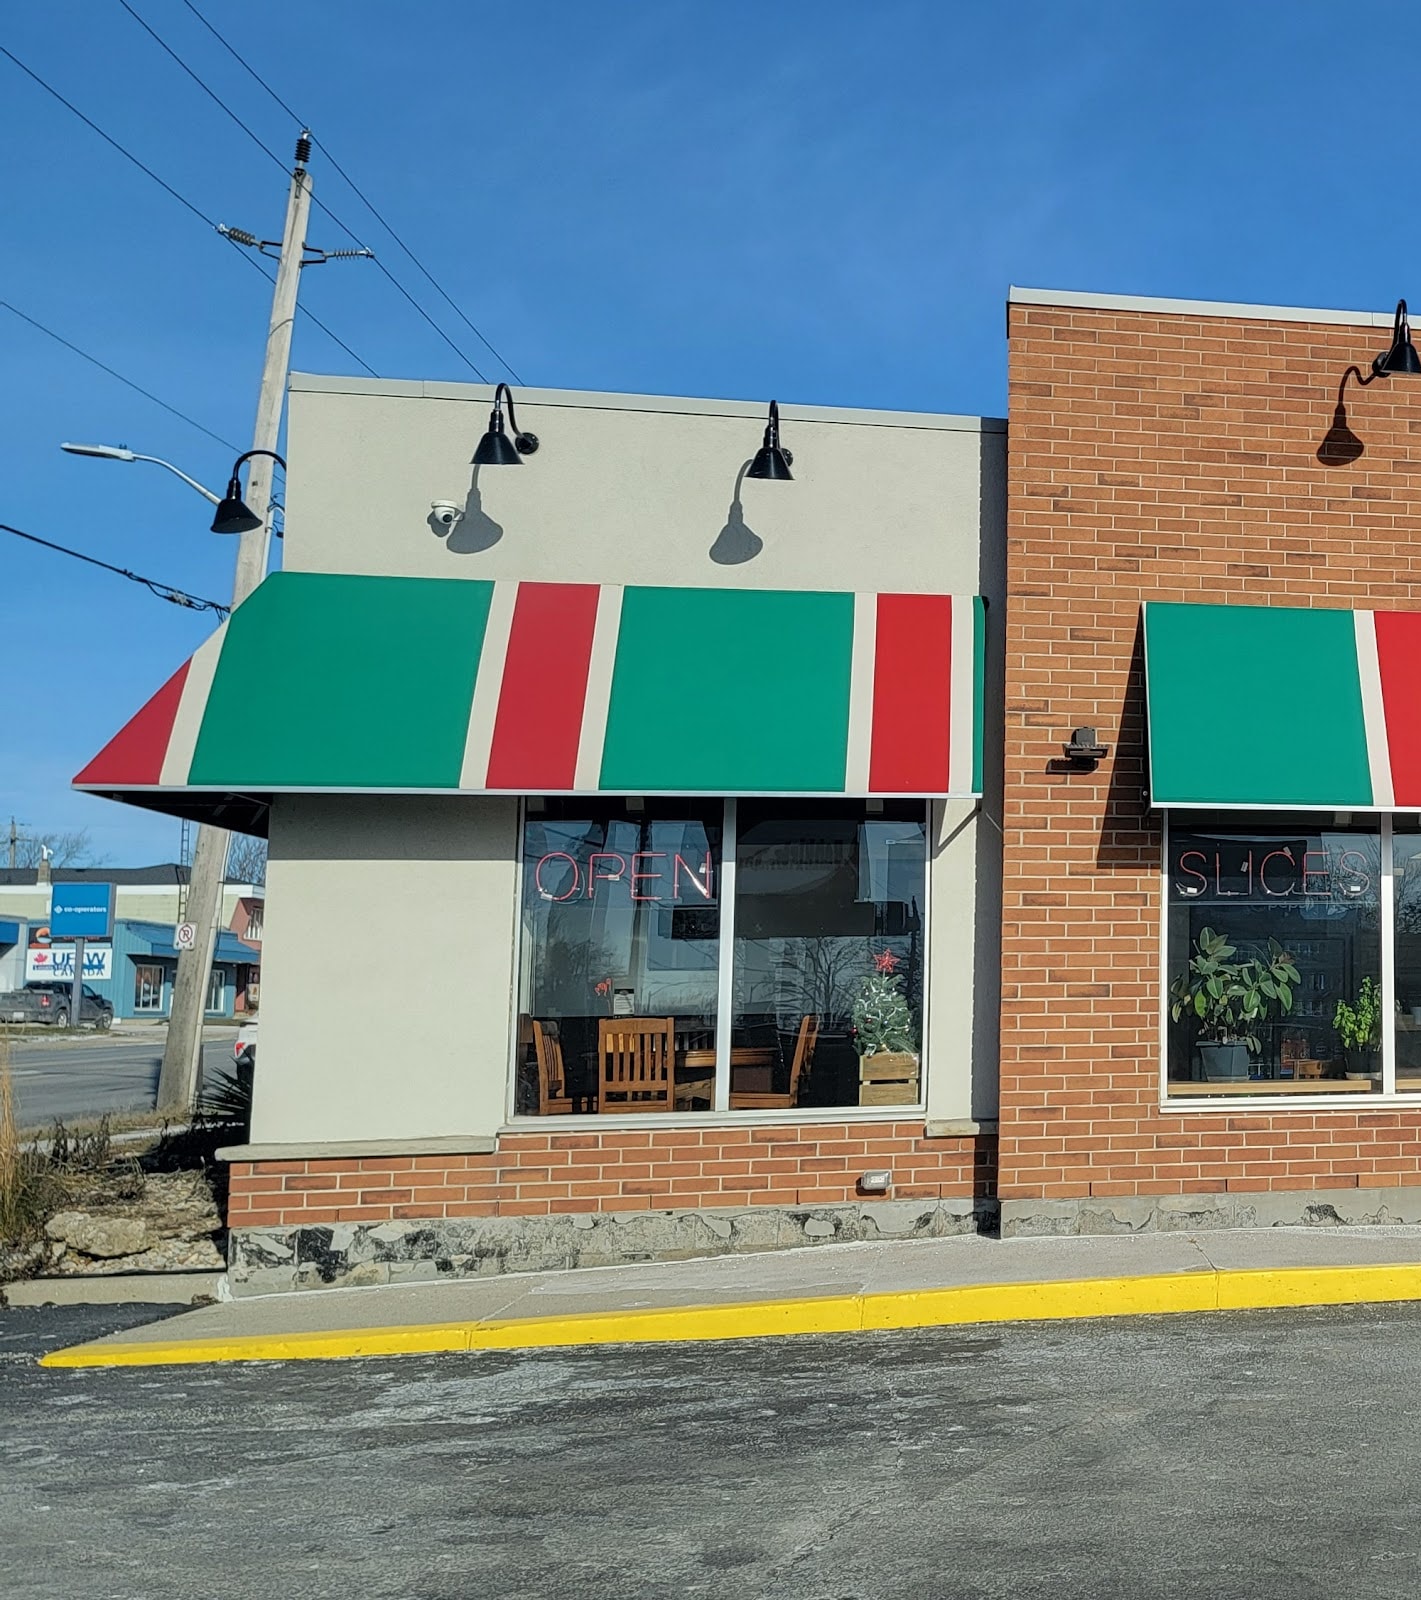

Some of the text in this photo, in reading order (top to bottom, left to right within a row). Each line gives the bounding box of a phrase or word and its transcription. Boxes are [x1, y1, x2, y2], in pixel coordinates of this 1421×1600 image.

[536, 851, 711, 900] OPEN
[1176, 850, 1371, 897] SLICES
[52, 951, 106, 967] UFW
[53, 966, 104, 977] CADA
